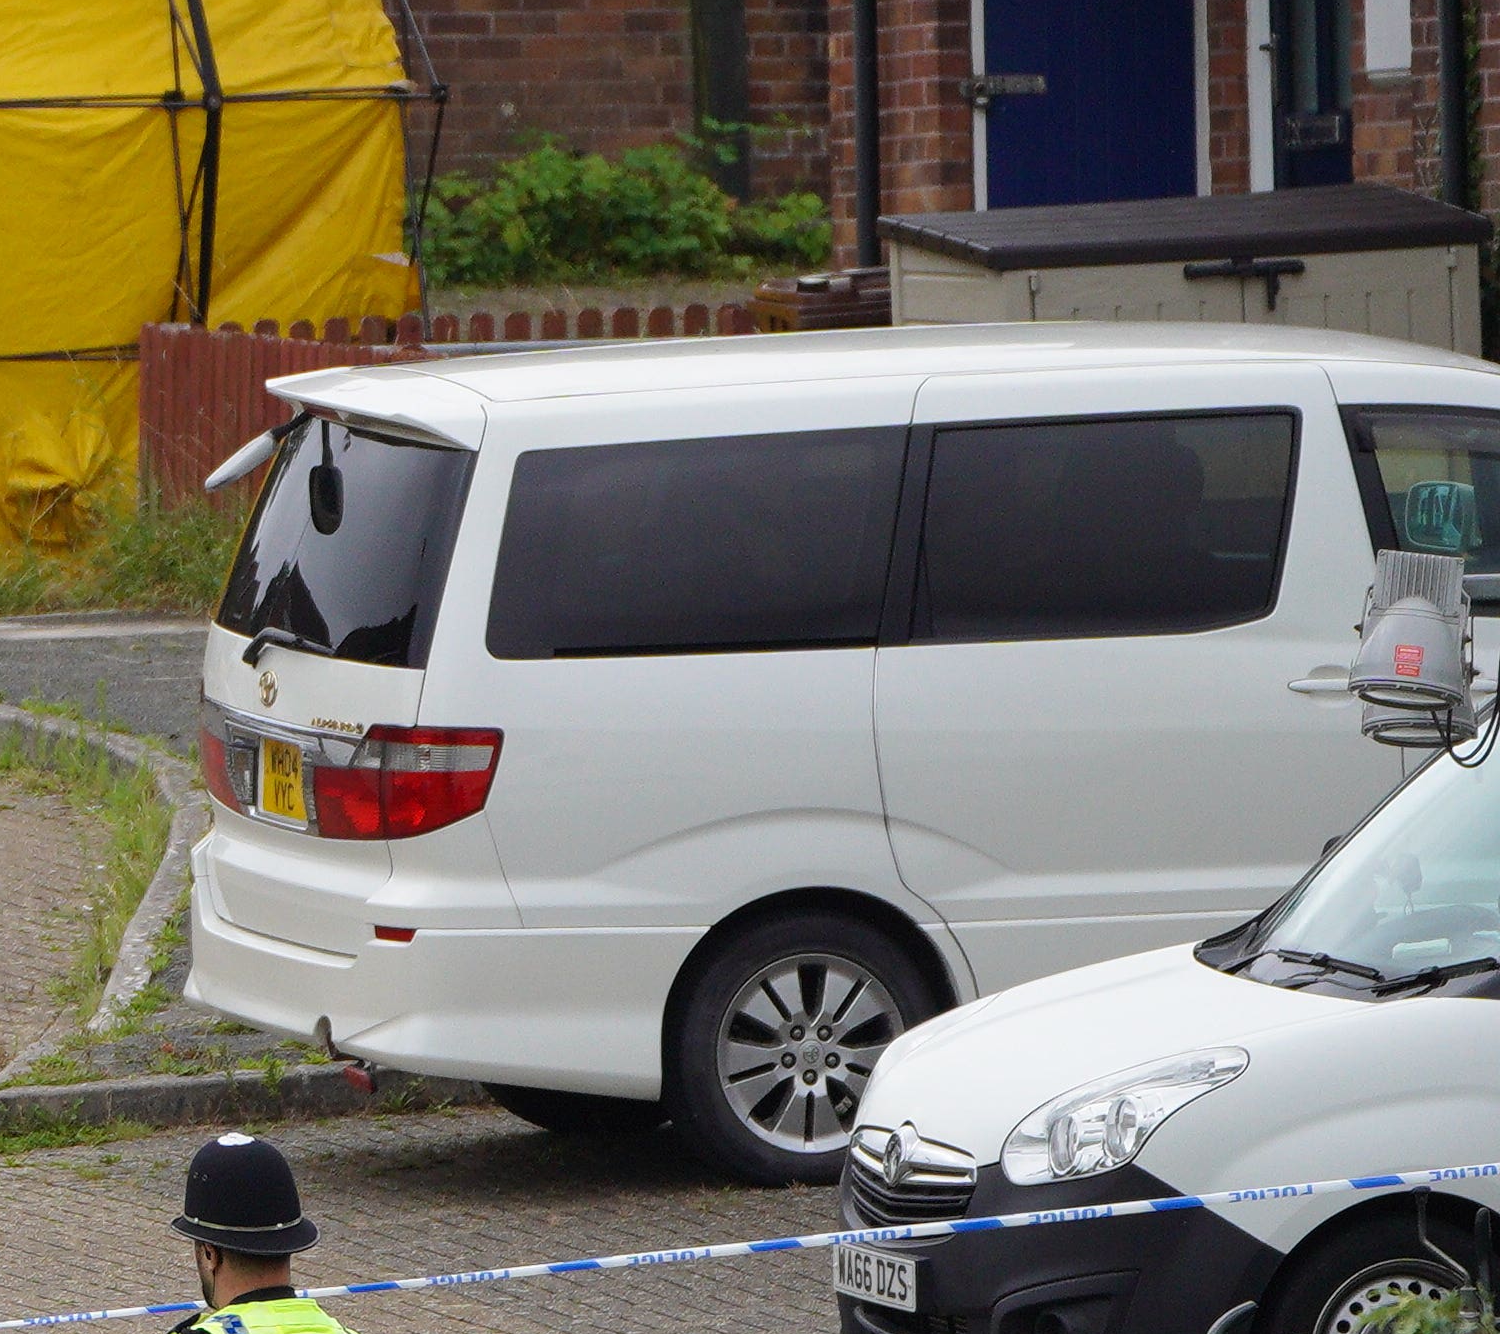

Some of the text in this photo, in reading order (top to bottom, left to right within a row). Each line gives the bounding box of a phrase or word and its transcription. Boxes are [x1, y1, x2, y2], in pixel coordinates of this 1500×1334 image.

[1429, 1165, 1499, 1182] OLICE
[837, 1248, 908, 1302] WA66 DZS
